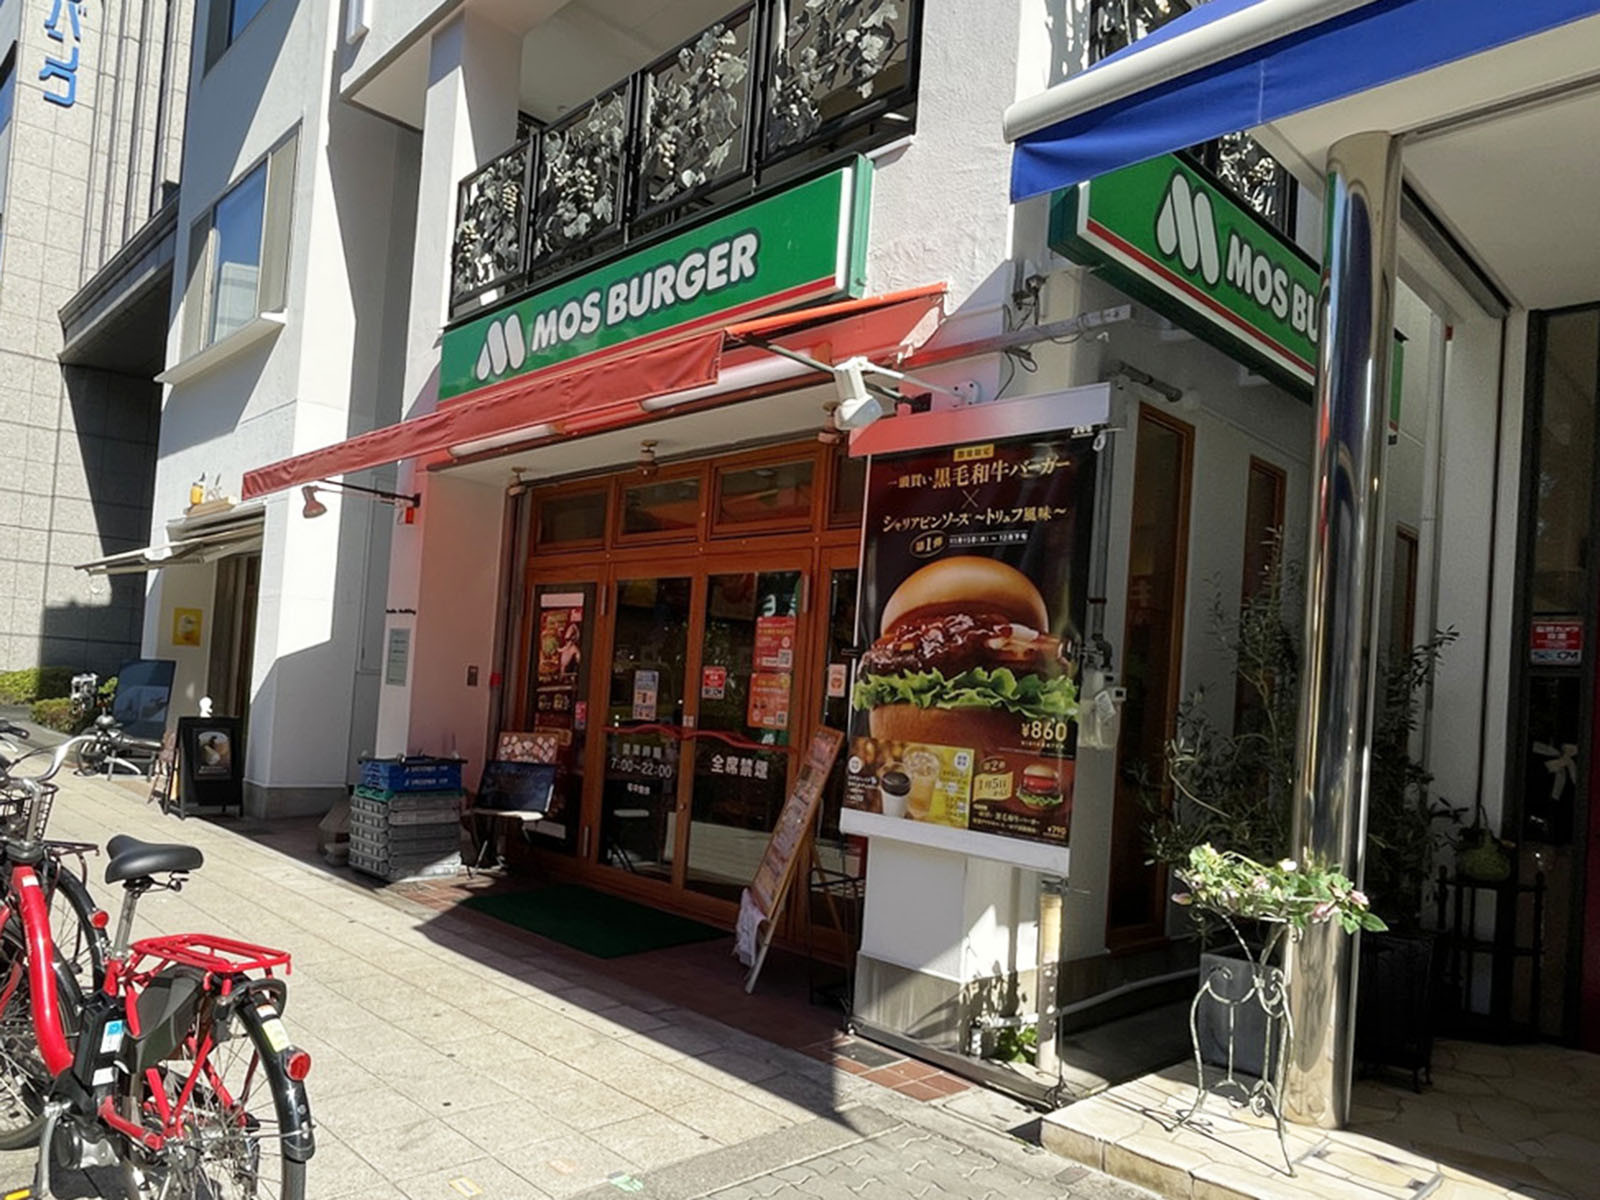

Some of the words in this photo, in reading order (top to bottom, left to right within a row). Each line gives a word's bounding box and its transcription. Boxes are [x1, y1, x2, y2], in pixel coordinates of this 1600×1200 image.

[532, 289, 602, 353] MOS
[606, 232, 759, 327] BURGER
[1225, 232, 1289, 319] MOS
[1021, 720, 1067, 742] ¥860
[711, 754, 769, 780] 全席禁煙
